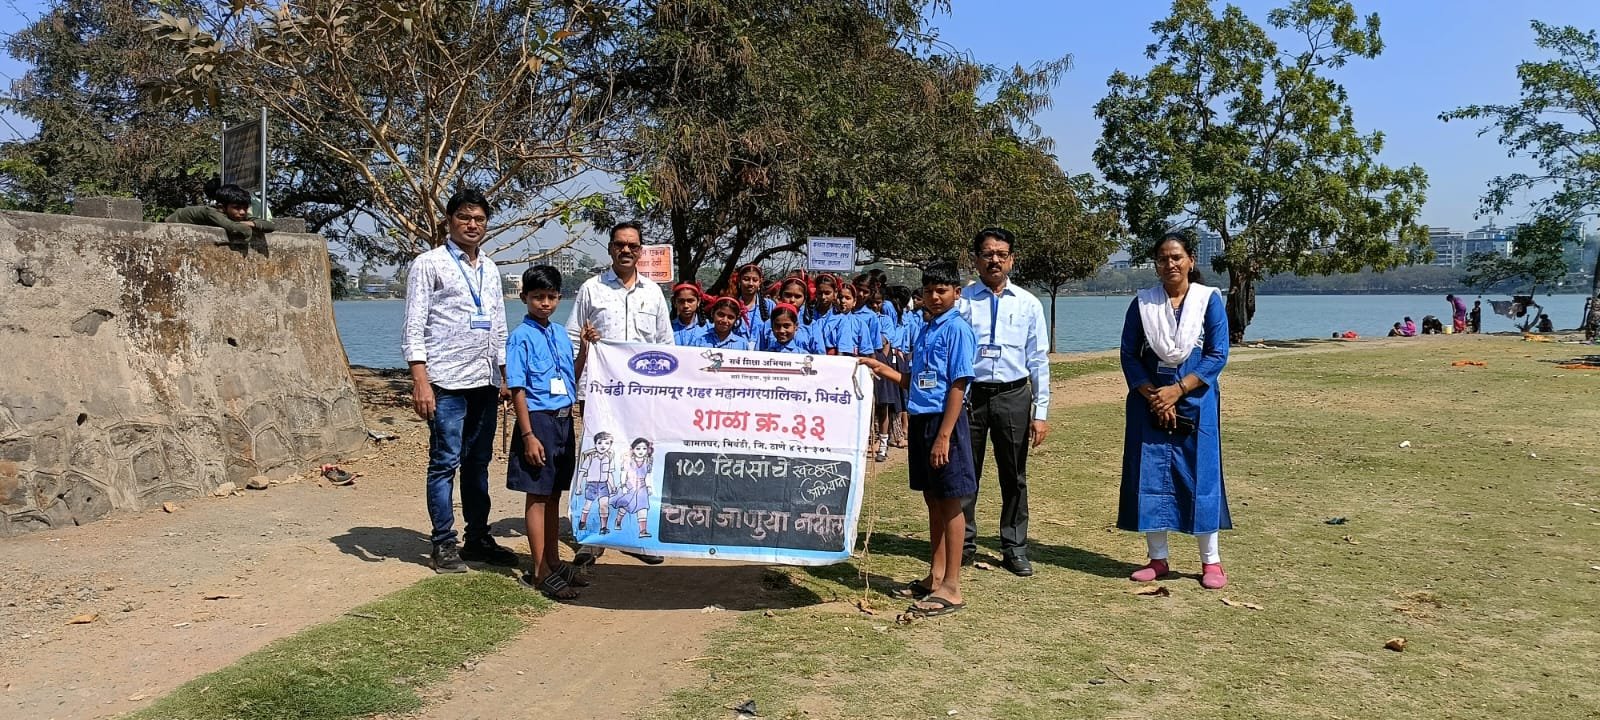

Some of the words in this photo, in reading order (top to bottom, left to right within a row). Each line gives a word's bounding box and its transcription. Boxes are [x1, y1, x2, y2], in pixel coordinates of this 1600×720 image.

[762, 358, 792, 367] अभियान
[590, 379, 625, 396] भिवंडी
[628, 381, 684, 400] निजामपूर
[686, 386, 712, 399] शहर
[715, 386, 811, 404] महानगरपालिका,
[815, 387, 852, 404] भिवंडी
[693, 409, 750, 431] शाळा
[770, 442, 786, 451] ठाणे
[661, 502, 712, 529] चला
